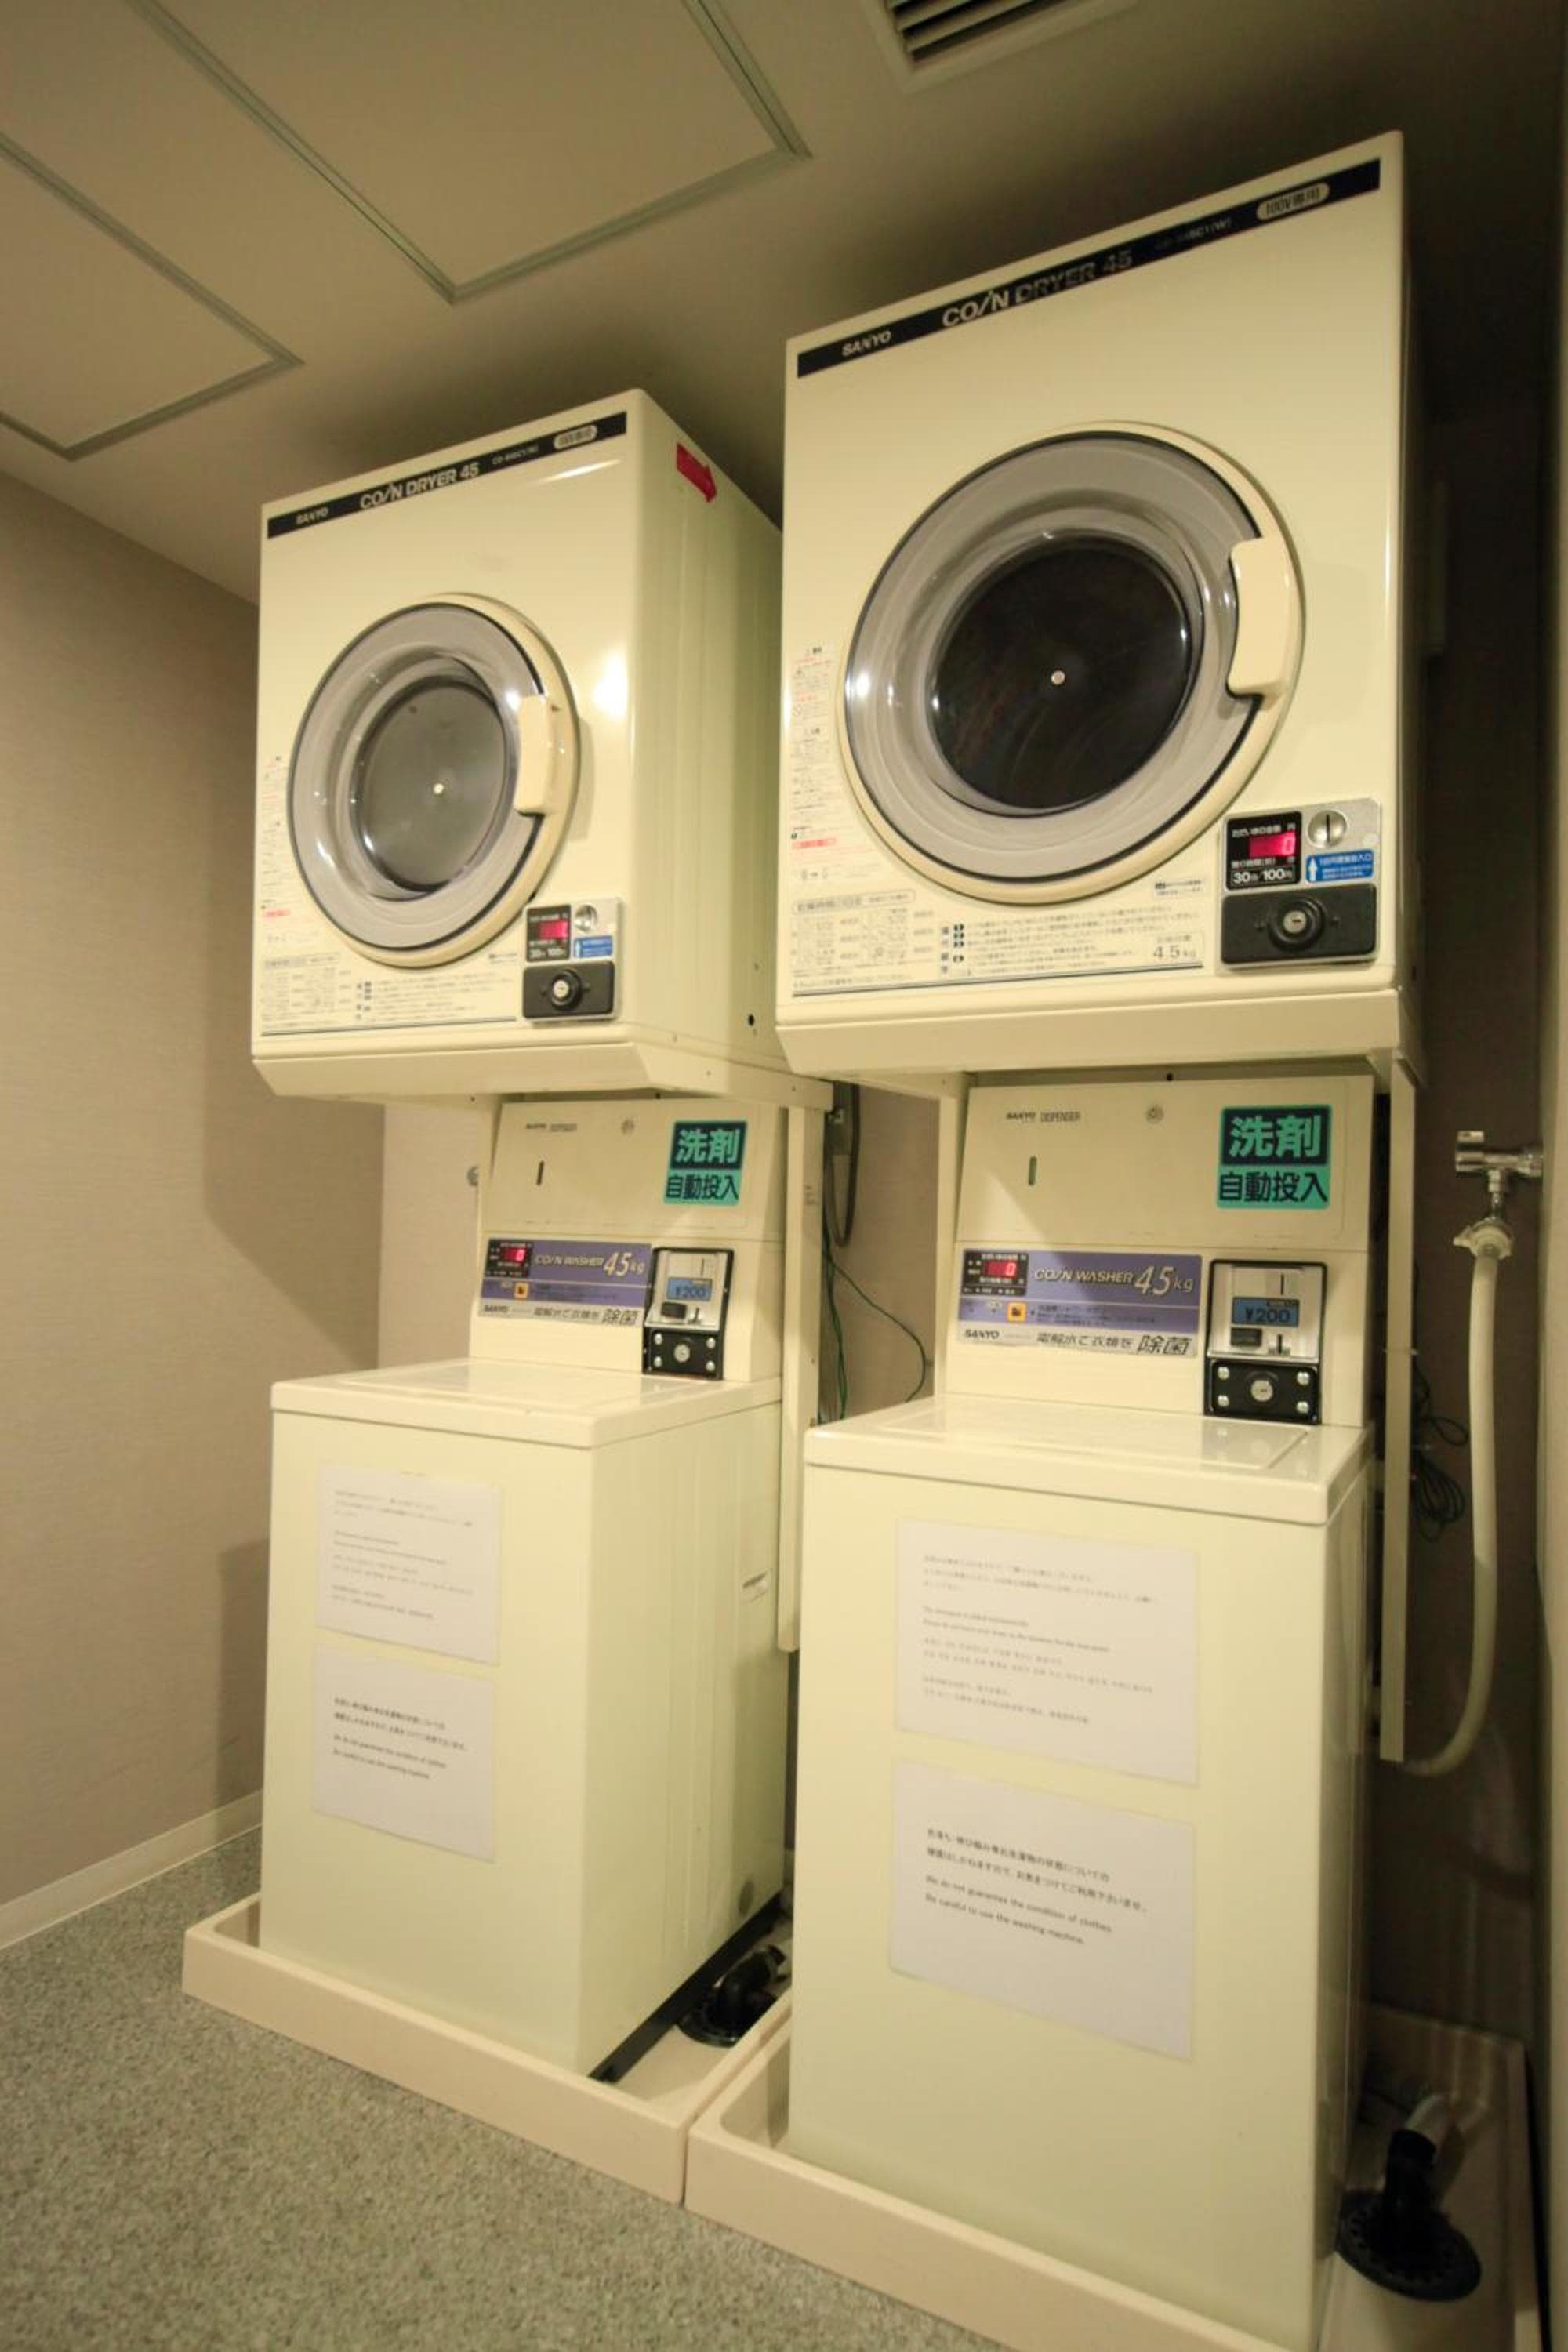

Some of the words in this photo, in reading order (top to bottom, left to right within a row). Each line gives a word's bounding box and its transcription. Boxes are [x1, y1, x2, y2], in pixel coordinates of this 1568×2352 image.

[842, 330, 891, 357] SANYO
[1014, 261, 1097, 304] DRYER
[1103, 248, 1134, 274] 45
[296, 507, 329, 525] SANYO
[405, 468, 457, 497] DRYER
[459, 462, 479, 480] 45
[1282, 837, 1295, 852] 0
[674, 1127, 740, 1163] 洗剤
[1229, 1113, 1321, 1159] 洗剤
[665, 1173, 739, 1200] 自動投入
[1219, 1171, 1329, 1203] 自動投入
[1004, 1261, 1017, 1277] 0
[1076, 1271, 1134, 1284] WASHER
[1244, 1306, 1291, 1323] ¥200
[964, 1329, 1000, 1339] SANYO
[1137, 1334, 1192, 1356] 除菌
[939, 1898, 966, 1911] careful
[978, 1910, 993, 1919] use
[996, 1912, 1010, 1923] the
[1012, 1919, 1044, 1935] washing
[1010, 1897, 1024, 1908] the
[1026, 1904, 1065, 1919] condition
[1068, 1913, 1077, 1922] of
